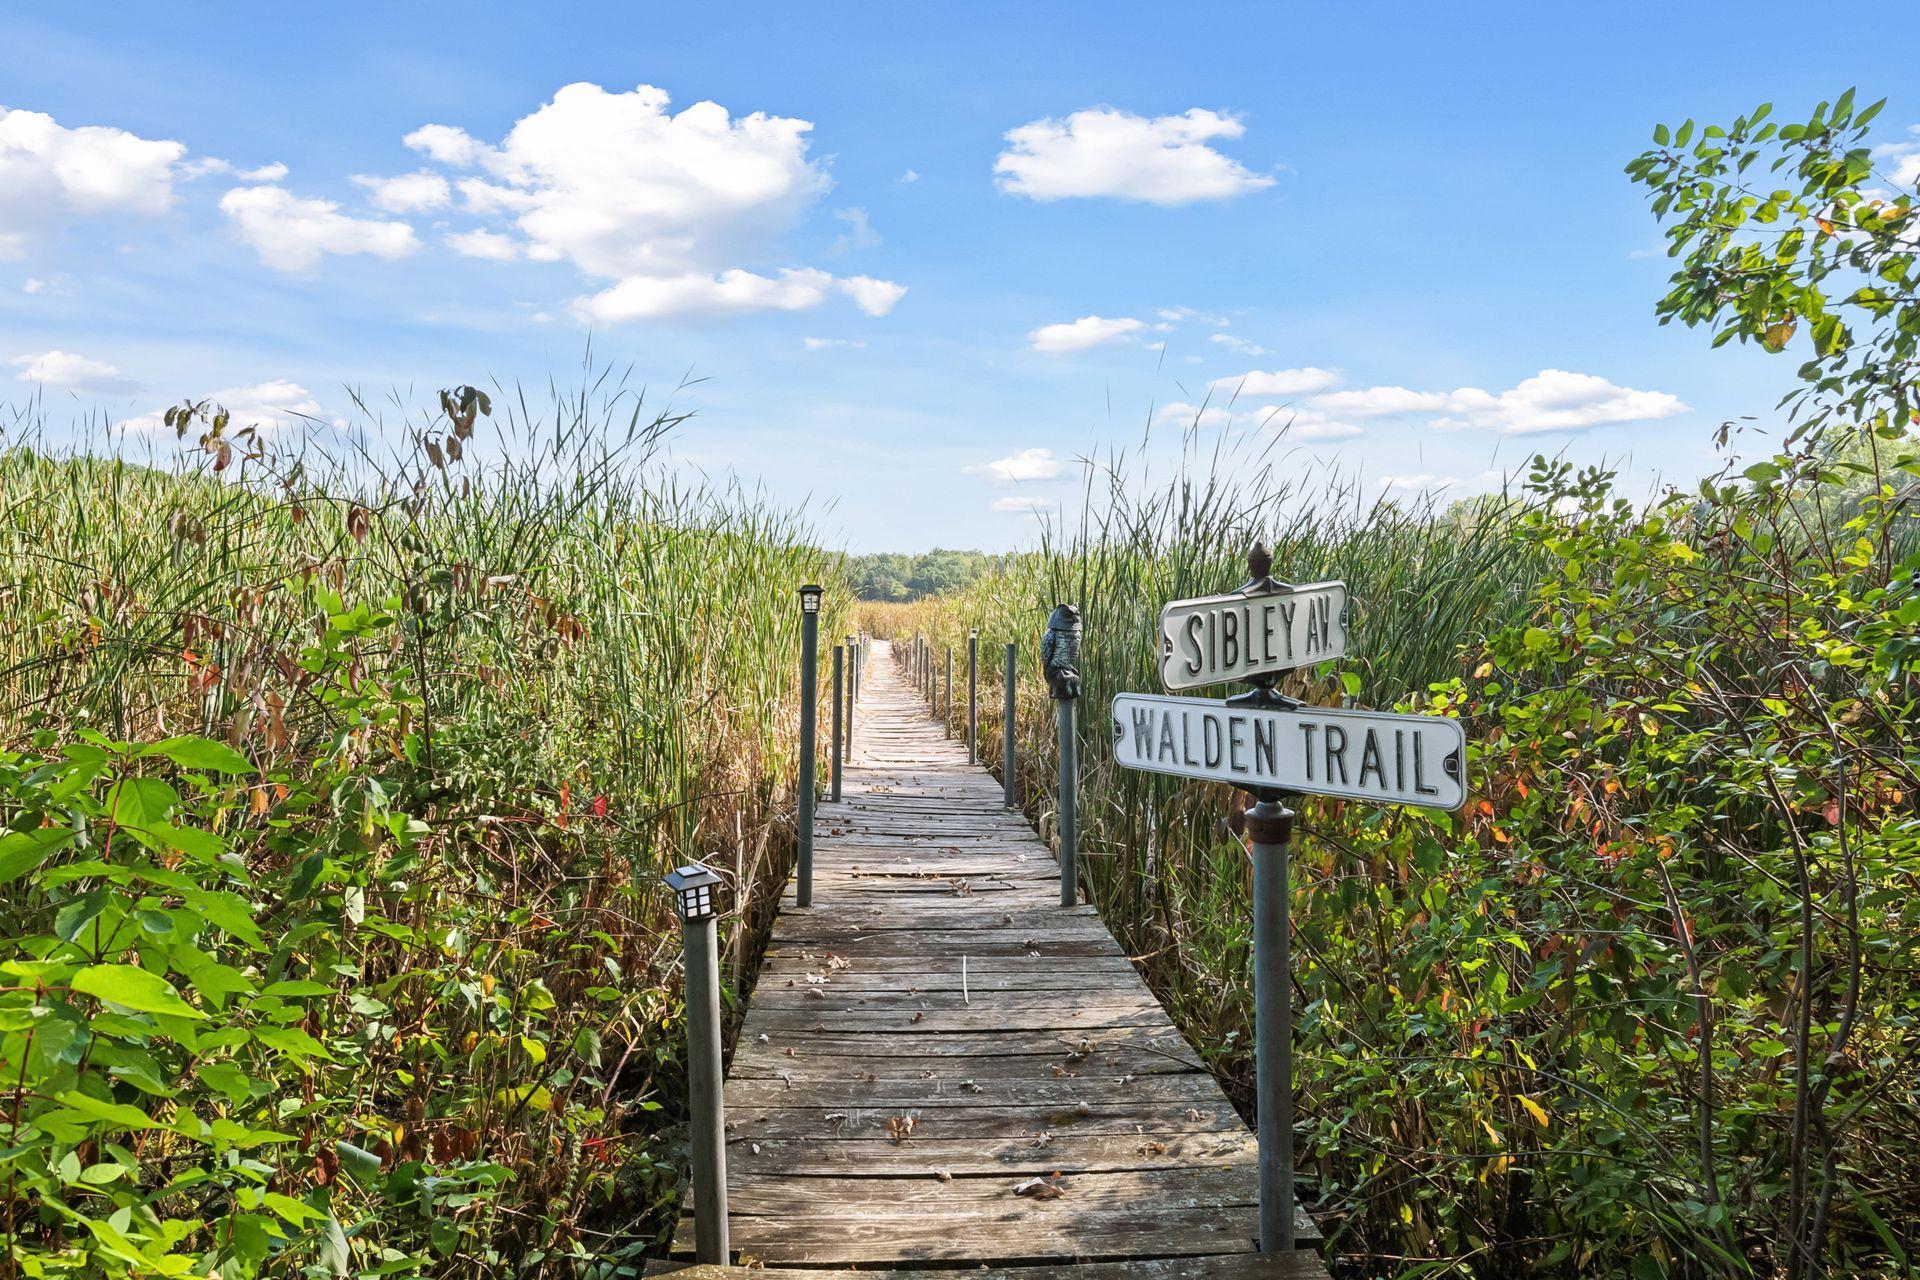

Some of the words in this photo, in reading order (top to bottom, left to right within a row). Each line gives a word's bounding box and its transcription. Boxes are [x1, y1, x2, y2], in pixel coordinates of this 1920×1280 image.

[1186, 601, 1296, 676] SIBLEY
[1306, 593, 1333, 655] AV.
[1131, 706, 1277, 776] WALDEN
[1298, 722, 1439, 795] TRAIL
